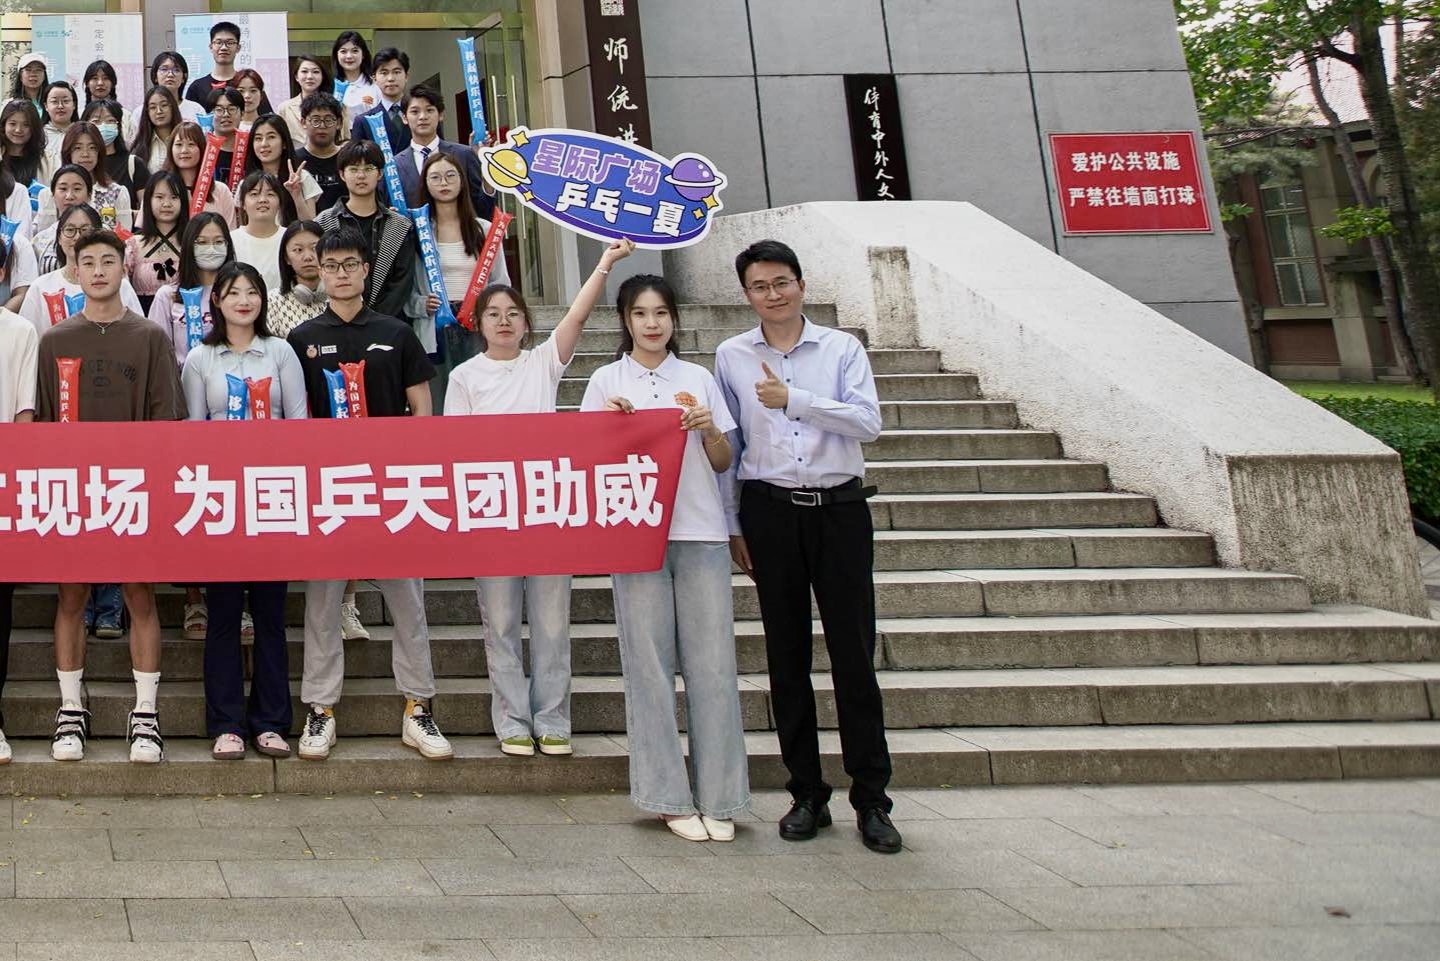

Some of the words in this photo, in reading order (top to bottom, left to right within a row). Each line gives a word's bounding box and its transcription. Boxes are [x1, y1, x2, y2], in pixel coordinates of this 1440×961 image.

[531, 138, 662, 196] 星际广场
[1071, 151, 1181, 172] 爱护公共设施
[555, 181, 686, 238] 乒乓一夏
[348, 381, 361, 418] 为国乒
[173, 454, 663, 537] 为国乒天团助威
